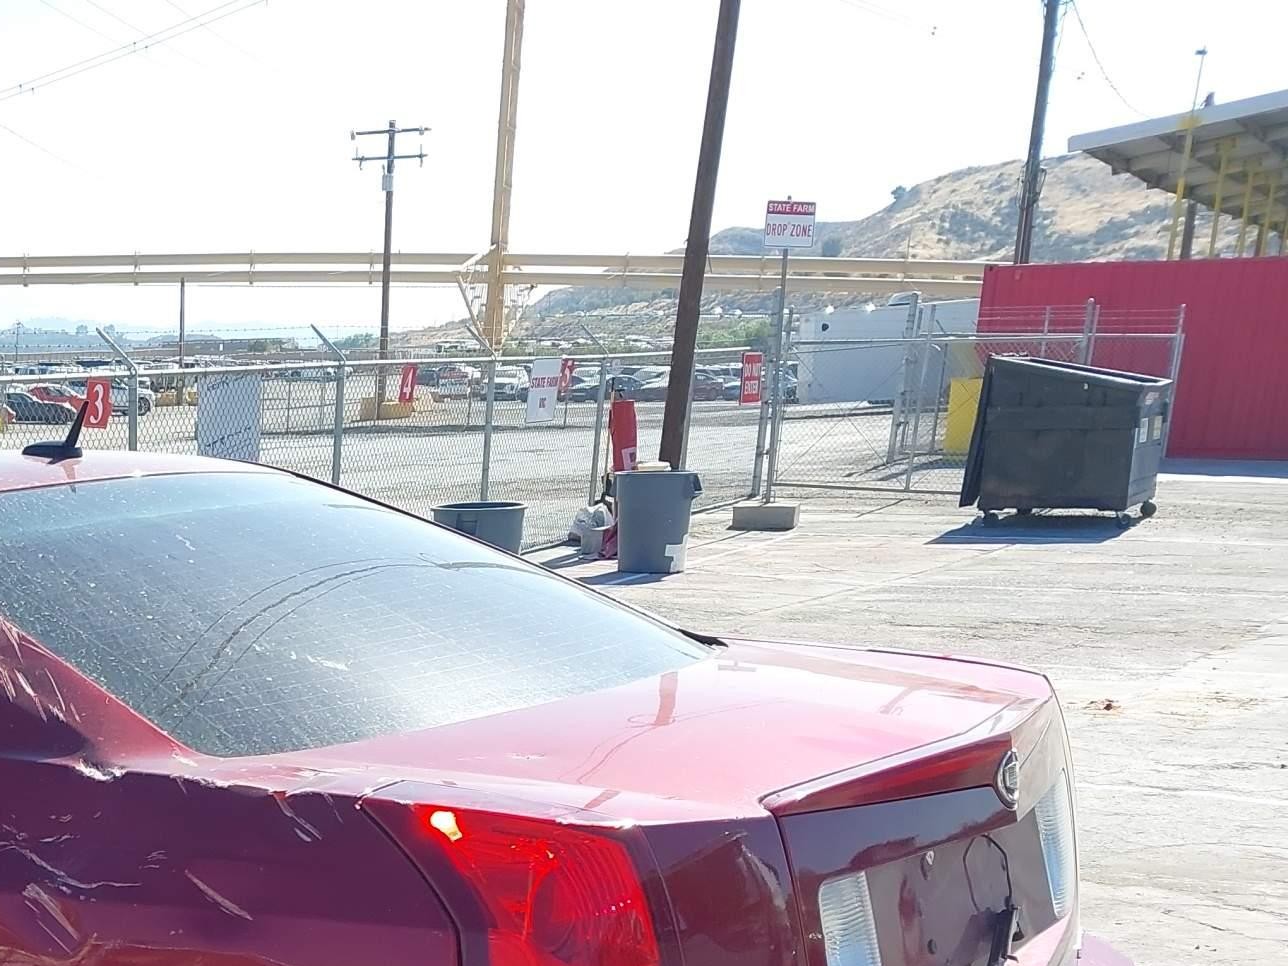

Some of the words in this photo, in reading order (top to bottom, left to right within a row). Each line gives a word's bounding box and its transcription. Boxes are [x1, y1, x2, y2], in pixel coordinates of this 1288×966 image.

[768, 203, 791, 212] STATE
[793, 204, 815, 213] FARM
[766, 223, 788, 236] DROP
[790, 224, 813, 237] ZONE
[402, 367, 414, 400] 4
[89, 384, 104, 424] 3
